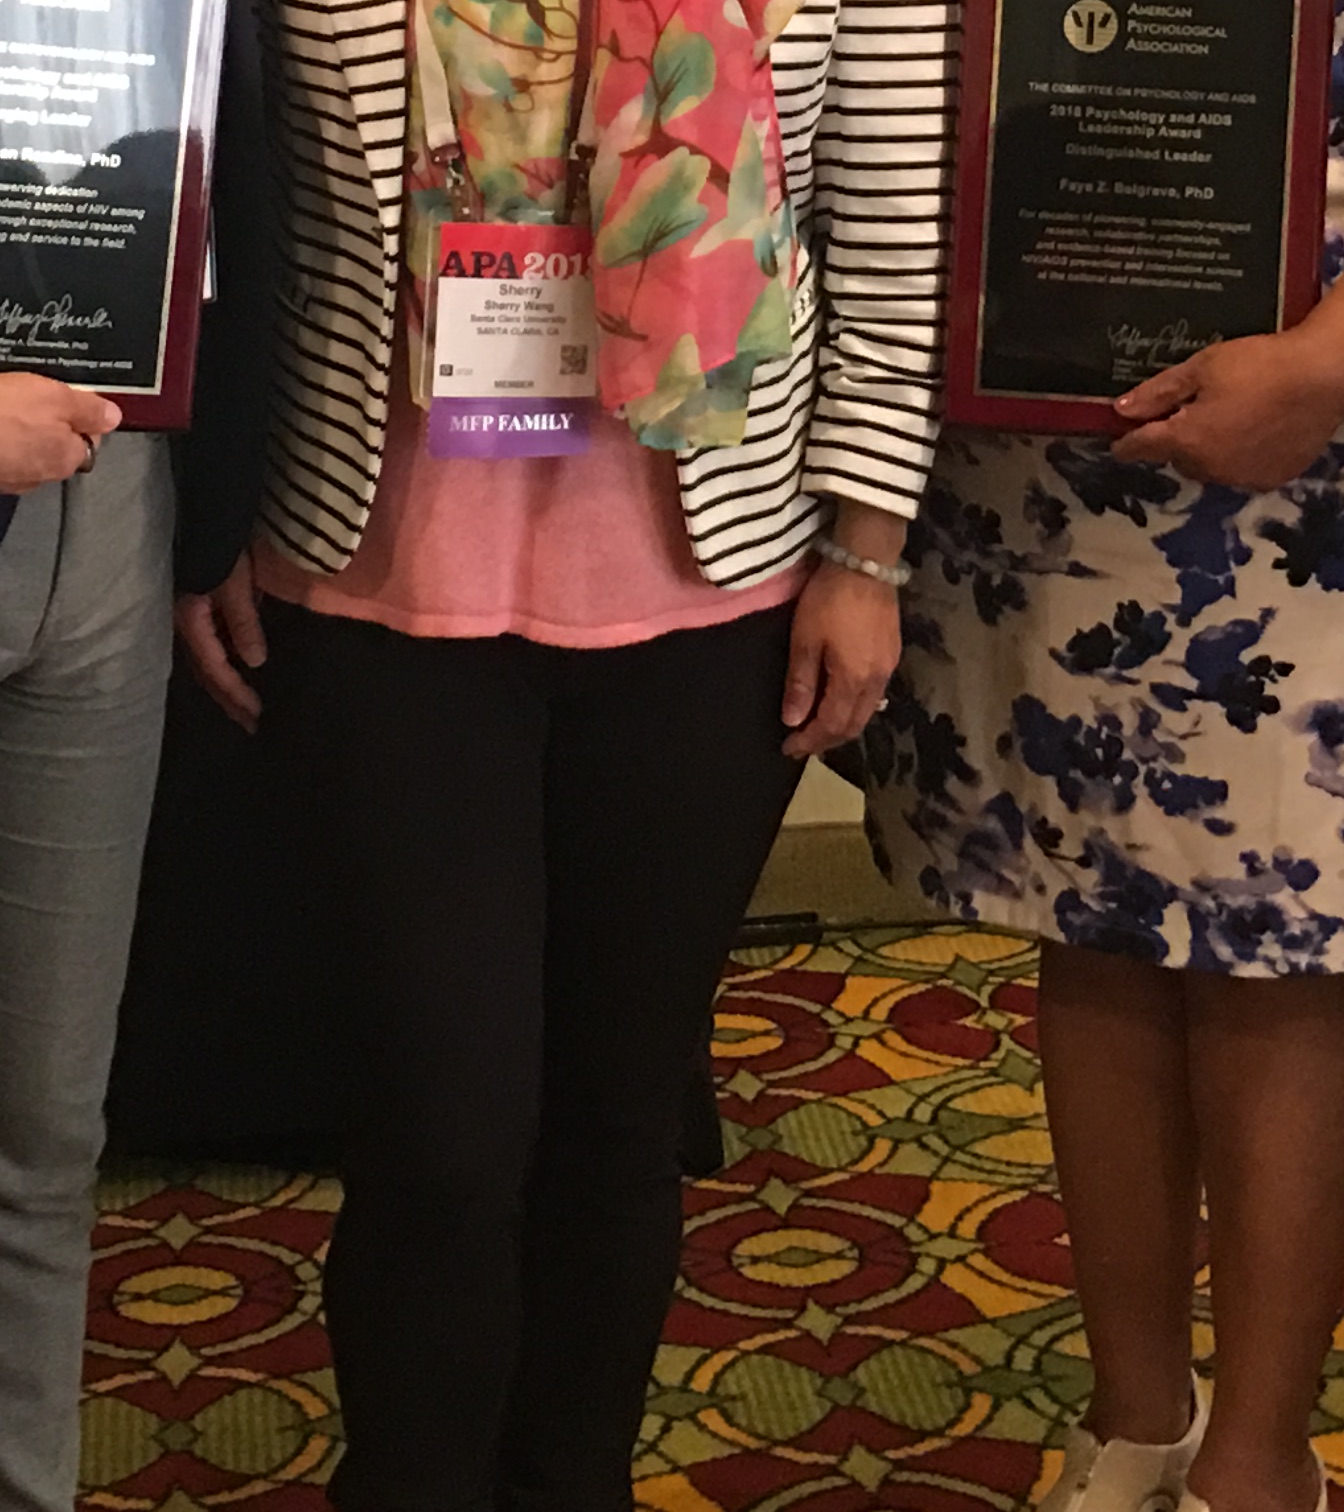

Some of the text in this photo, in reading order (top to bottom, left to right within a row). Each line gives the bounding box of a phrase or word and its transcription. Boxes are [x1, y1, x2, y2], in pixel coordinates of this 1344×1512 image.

[1127, 3, 1193, 18] AMERICAN
[1127, 20, 1228, 38] PSYCHOLOGICAL
[1124, 37, 1209, 55] ASSOCIATION
[1028, 81, 1256, 104] THE COMMITTEE ON PSYCHOLOGY AND AIDS
[1049, 104, 1232, 126] 2018 Psychology and AIDS
[1078, 122, 1202, 139] Leadership Award
[90, 153, 121, 168] PhD
[1065, 143, 1212, 163] Distinguished Leader
[1059, 178, 1093, 194] Faye
[1184, 186, 1214, 200] PhD
[76, 202, 88, 214] of
[88, 204, 110, 215] HIV
[110, 208, 146, 221] among
[499, 283, 542, 299] Sherry
[484, 299, 555, 313] Sherry Wang
[476, 327, 508, 335] SANTA
[546, 327, 560, 335] CA
[450, 412, 574, 432] MFP FAMILY
